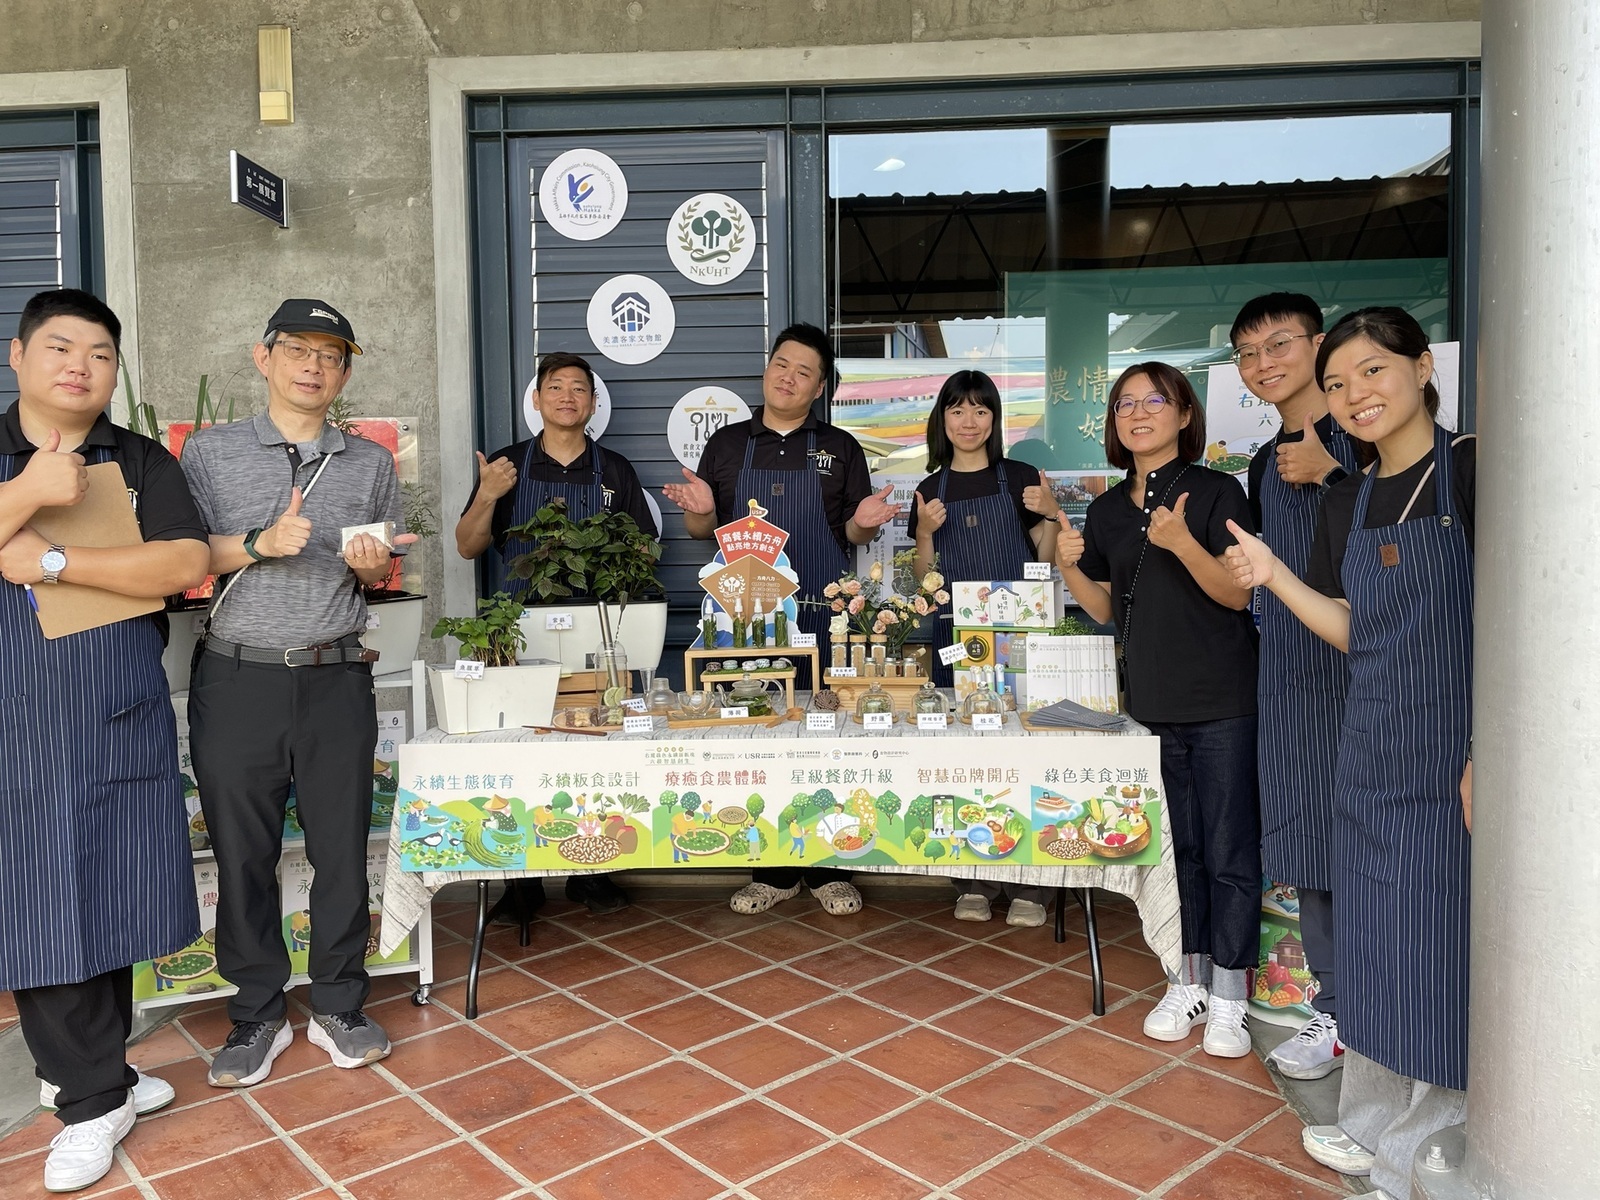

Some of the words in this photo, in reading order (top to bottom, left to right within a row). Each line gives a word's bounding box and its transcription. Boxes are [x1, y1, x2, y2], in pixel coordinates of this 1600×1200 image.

[690, 266, 730, 277] NKUHT
[603, 334, 662, 344] 美濃客家文物館
[1049, 366, 1113, 405] 農情
[1258, 413, 1274, 427] 六
[1078, 412, 1107, 445] 好
[722, 530, 782, 546] 高餐永續方舟
[726, 542, 775, 554] 點亮地方創生
[413, 774, 514, 790] 永續生態復育
[538, 772, 640, 788] 永續粄食設計
[665, 770, 767, 786] 療癒食農體驗
[790, 768, 893, 784] 星級餐飲升級
[917, 768, 1020, 784] 智慧品牌開店
[1044, 767, 1149, 784] 綠色美食迴遊
[297, 880, 312, 894] 永
[203, 892, 217, 908] 農
